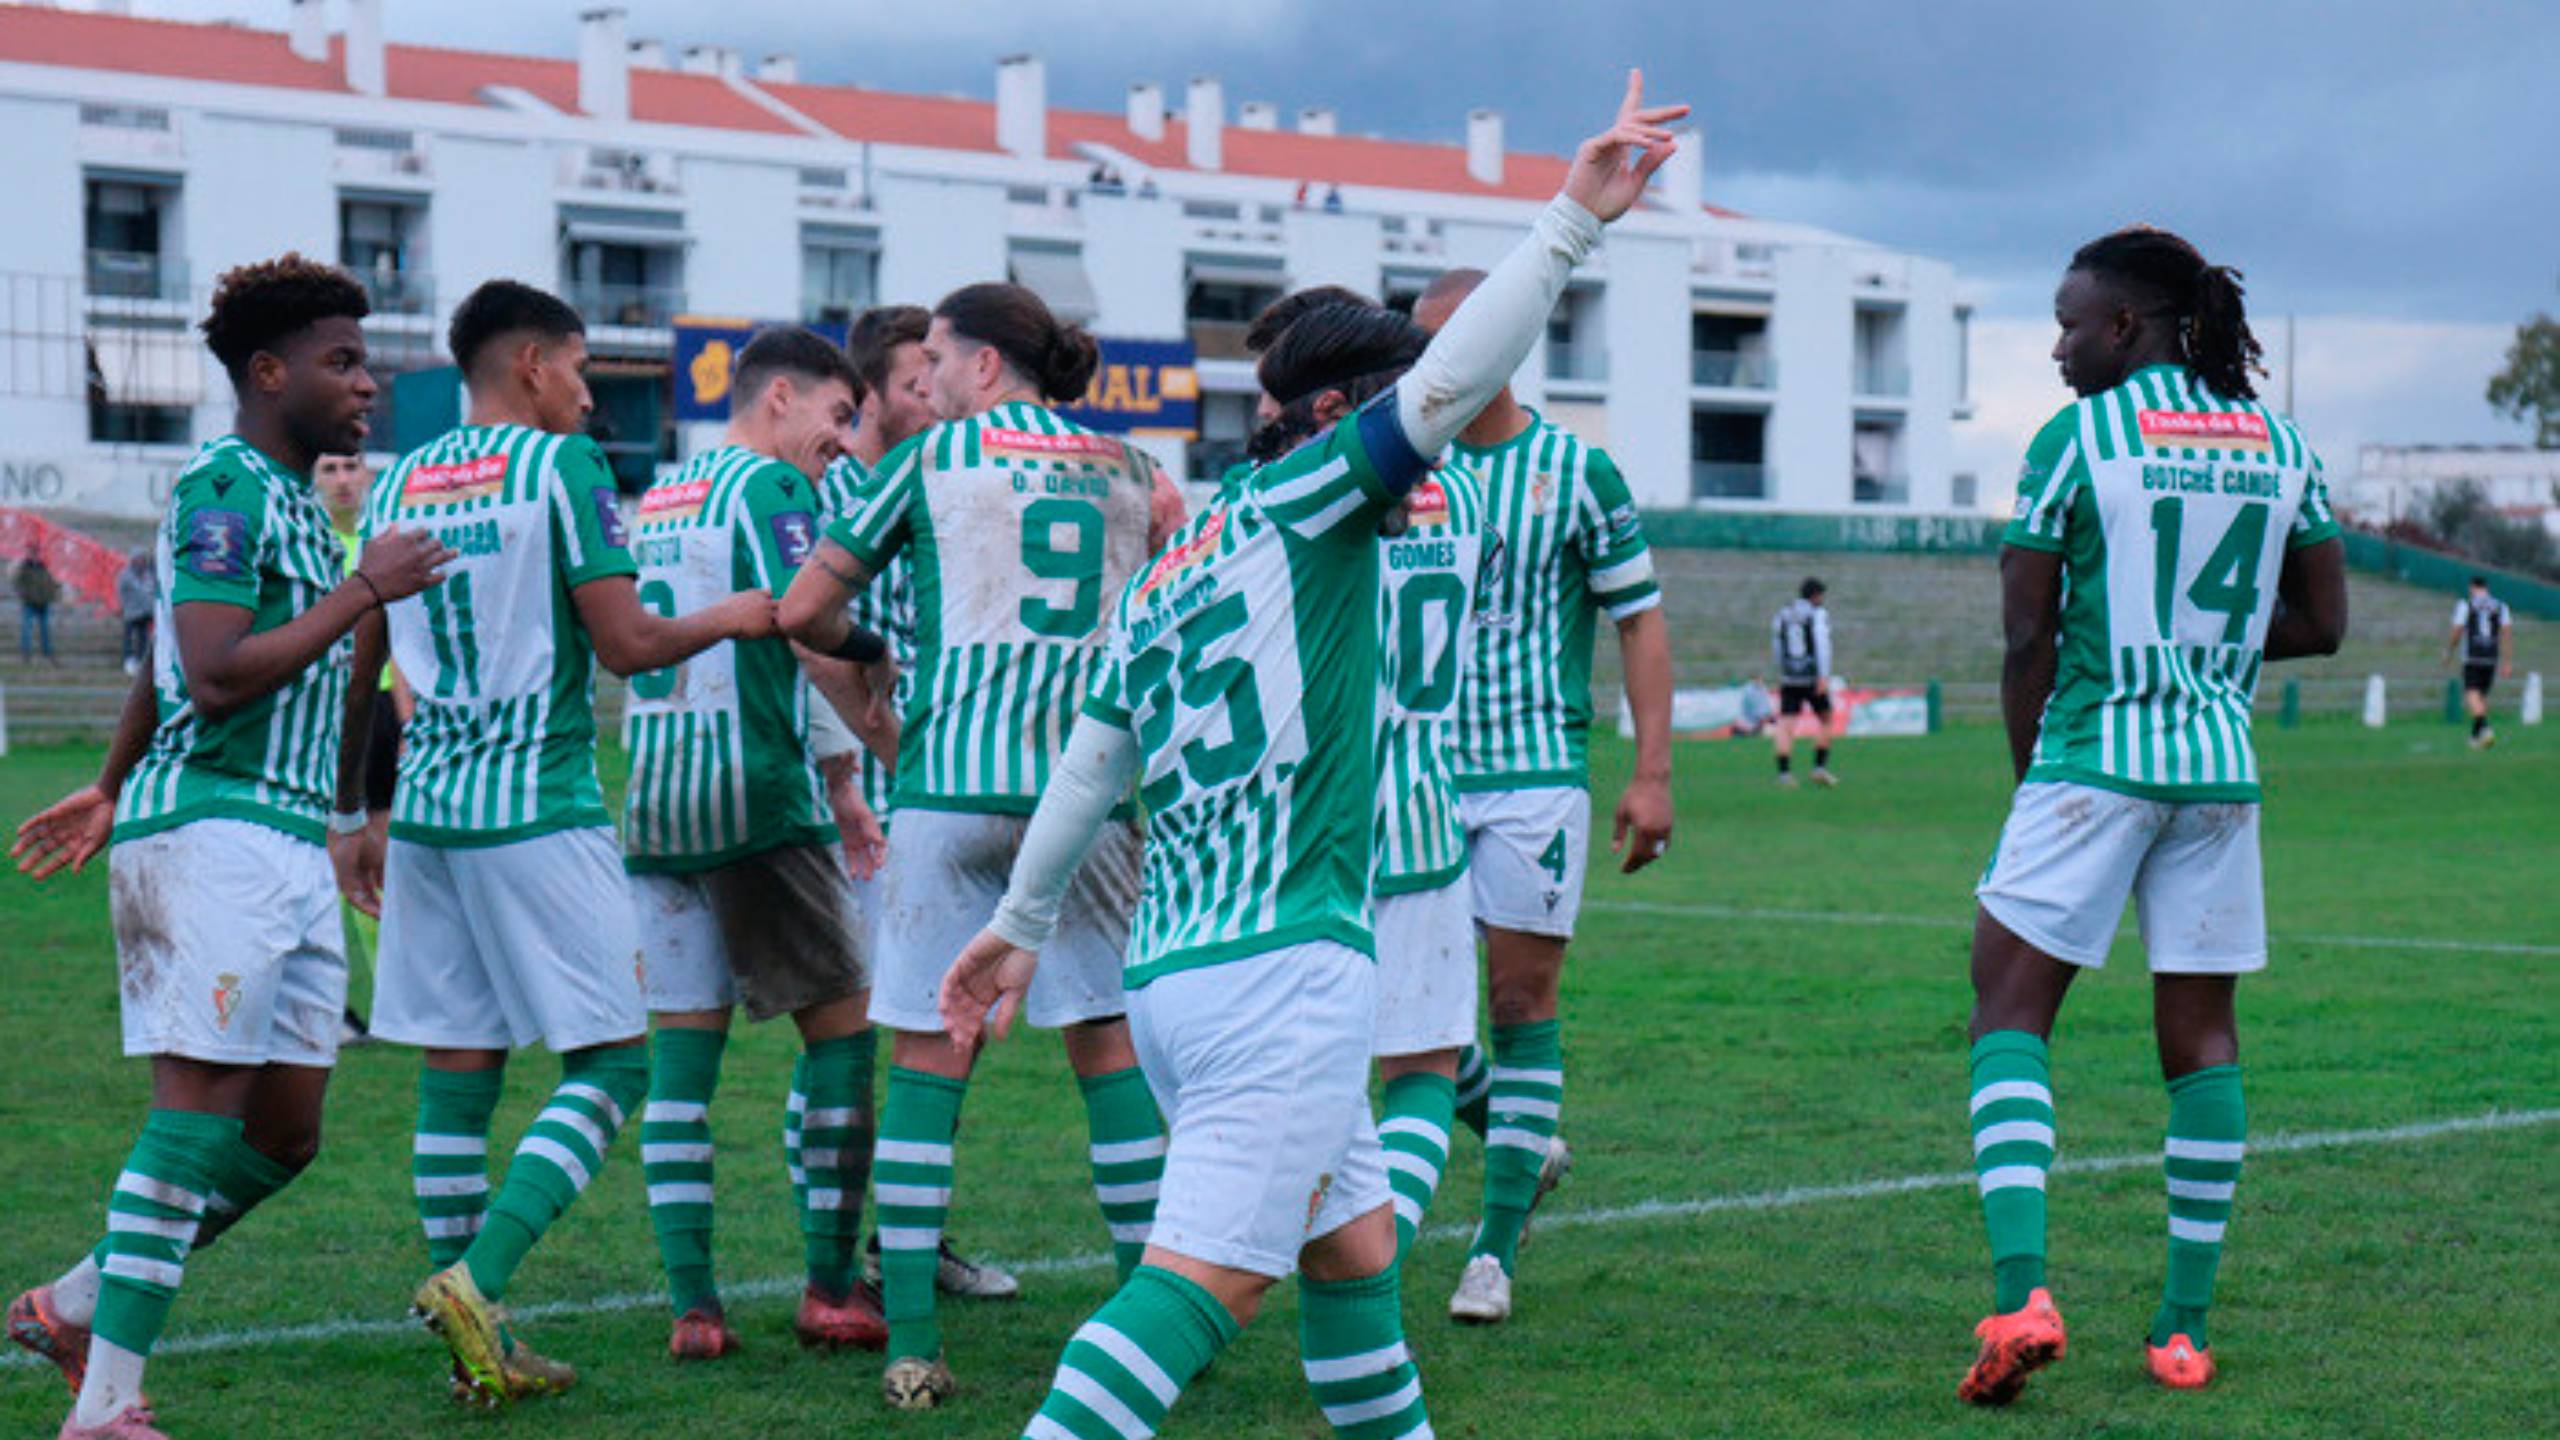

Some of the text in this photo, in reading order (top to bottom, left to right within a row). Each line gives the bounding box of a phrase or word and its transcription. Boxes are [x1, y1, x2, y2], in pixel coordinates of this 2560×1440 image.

[1019, 498, 1106, 640] 9
[1388, 541, 1457, 571] GOMES
[2151, 496, 2269, 643] 14
[1125, 590, 1268, 813] 25
[1538, 827, 1567, 883] 4
